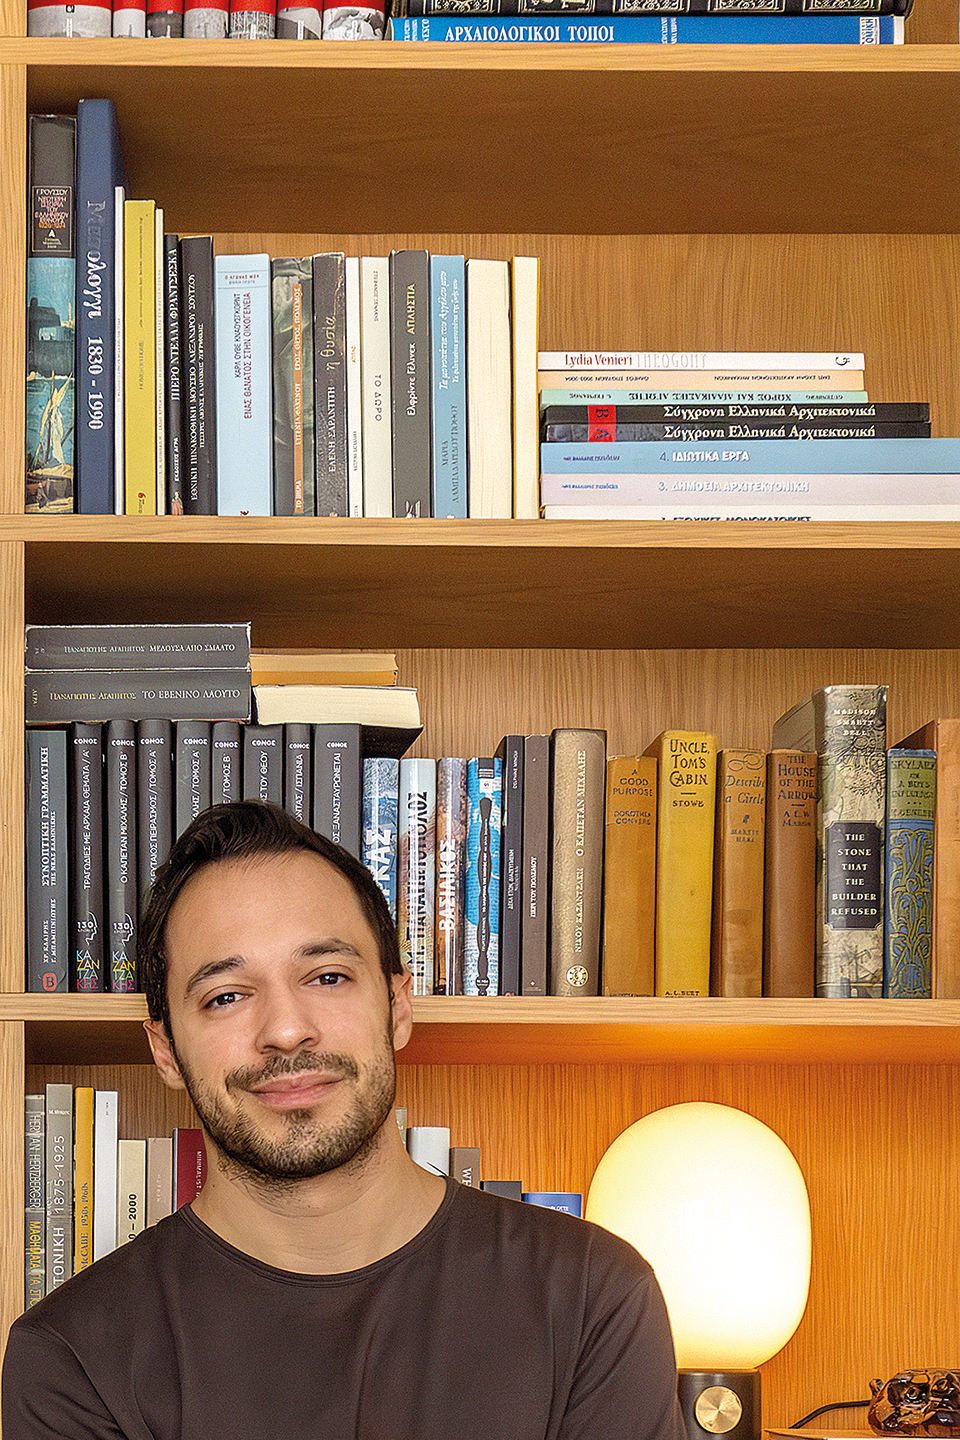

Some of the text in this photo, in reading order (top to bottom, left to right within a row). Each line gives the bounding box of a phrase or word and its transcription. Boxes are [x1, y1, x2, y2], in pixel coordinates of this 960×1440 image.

[444, 26, 559, 42] ΑΡΧΑΙΟΛΟΓΙΚΟΙ
[566, 26, 614, 42] ΤΟΠΟΙ
[406, 283, 415, 334] ΑΠΛΗΣΤΙΑ
[87, 337, 104, 375] 1830
[243, 292, 252, 419] ΕΝΑΣ ΘΑΝΑΤΟΣ ΣΤΗΝ ΟΙΚΟΓΕΝΕΙΑ
[565, 354, 633, 368] Lydia Venieri
[171, 365, 180, 401] ΠΙΕΡΟ
[374, 374, 382, 422] ΤΟ ΔΩΡΟ
[87, 391, 104, 430] 1990
[663, 404, 876, 421] Σύγχρονη Ελληνική Αρχιτεκτονική
[663, 425, 876, 440] Σύγχρονη Ελληνική Αρχιτεκτονική
[673, 450, 720, 462] ΙΔΙΩΤΙΚΑ
[722, 450, 750, 462] ΕΡΓΑ
[141, 690, 240, 699] ΤΟ ΕΒΕΝΙΝΟ ΛΑΟΥΤΟ
[671, 754, 707, 769] TOM'S
[669, 770, 708, 787] CABIN
[40, 747, 50, 886] ΣΥΝΟΠΤΙΚΗ ΓΡΑΜΜΑΤΙΚΗ
[844, 833, 865, 841] THE
[837, 848, 872, 856] STONE
[842, 863, 868, 871] THAT
[844, 878, 865, 886] THE
[832, 893, 877, 901] BUILDER
[831, 908, 877, 916] REFUSED
[77, 921, 93, 929] 130
[76, 950, 92, 960] ΚΑ
[77, 959, 100, 970] ΖΑΝ
[77, 969, 98, 979] ΤΖΑ
[76, 979, 98, 989] ΚΗΣ
